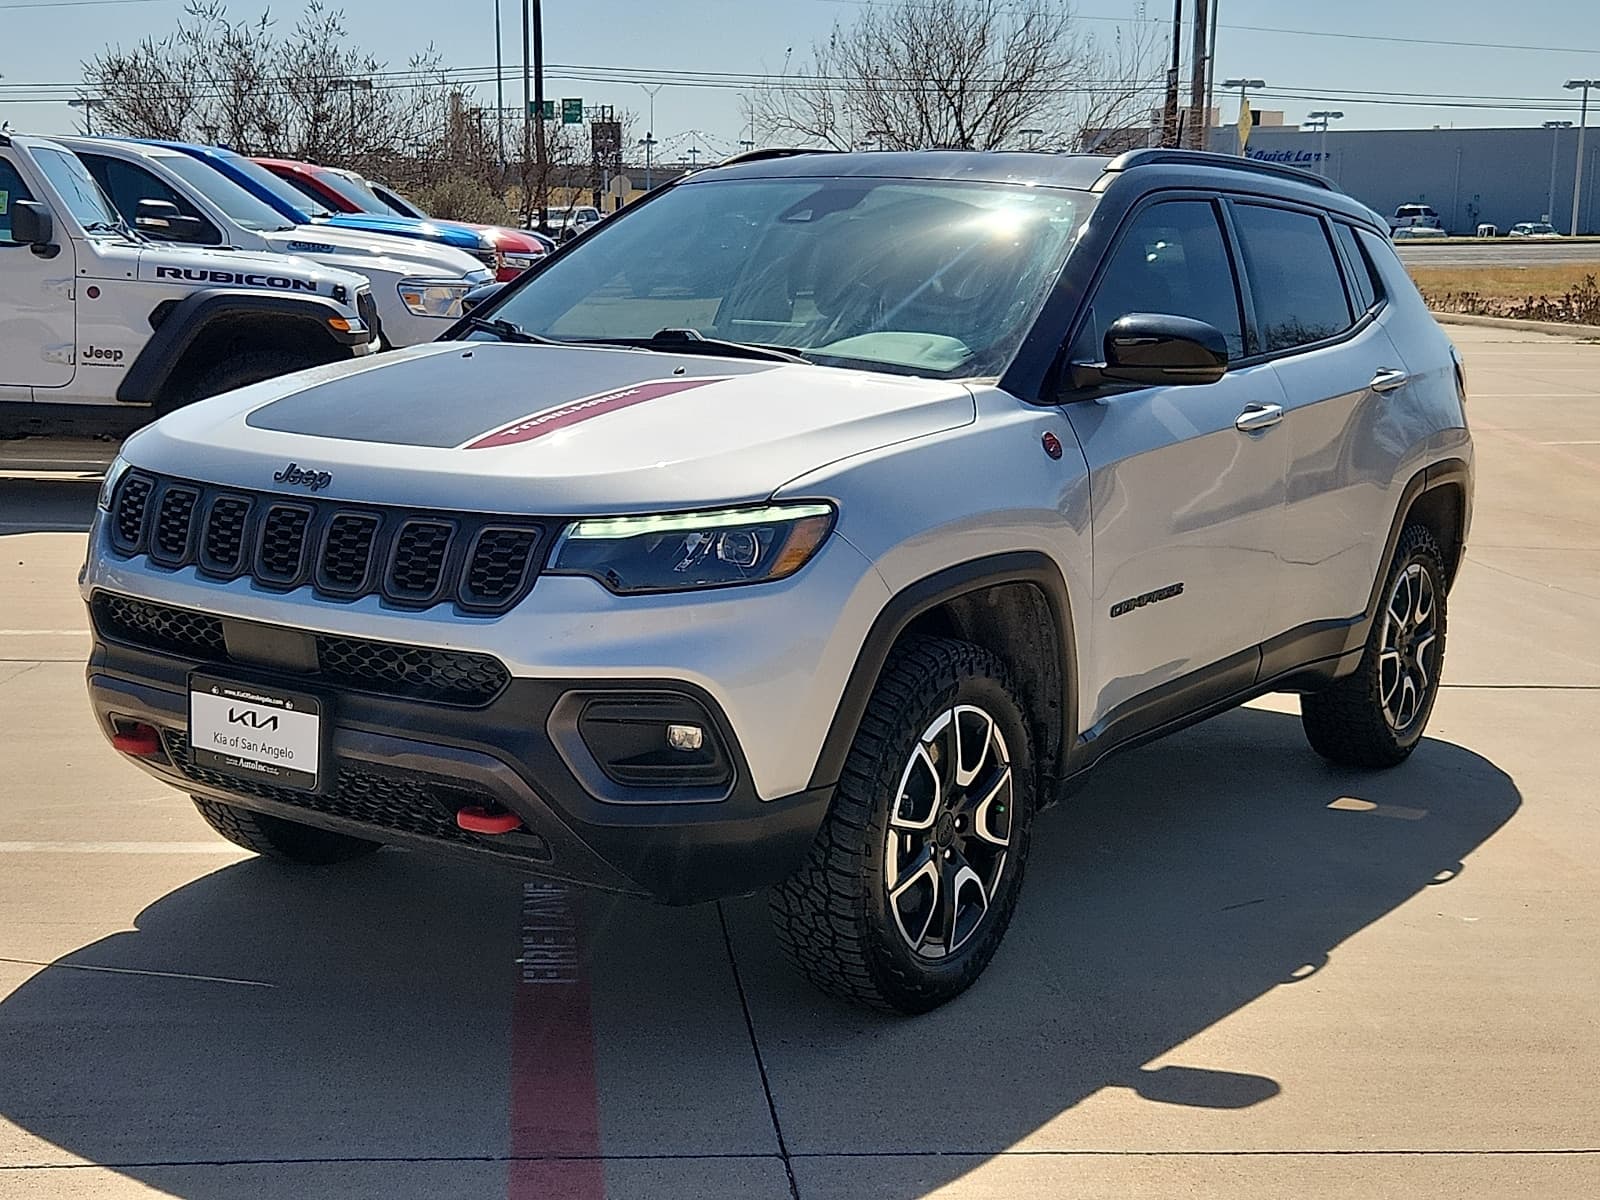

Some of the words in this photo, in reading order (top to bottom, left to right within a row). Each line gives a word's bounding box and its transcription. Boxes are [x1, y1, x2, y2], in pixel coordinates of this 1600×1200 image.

[1254, 150, 1293, 162] Quick
[156, 266, 317, 291] RUBICON
[83, 345, 124, 361] Jeep
[500, 389, 640, 436] TRAILHAWK
[273, 462, 333, 492] Jeep
[228, 706, 280, 732] KIA
[213, 731, 228, 745] Kia
[229, 736, 240, 748] of
[241, 738, 258, 753] San
[260, 743, 294, 760] Angelo
[523, 937, 577, 984] FIRE
